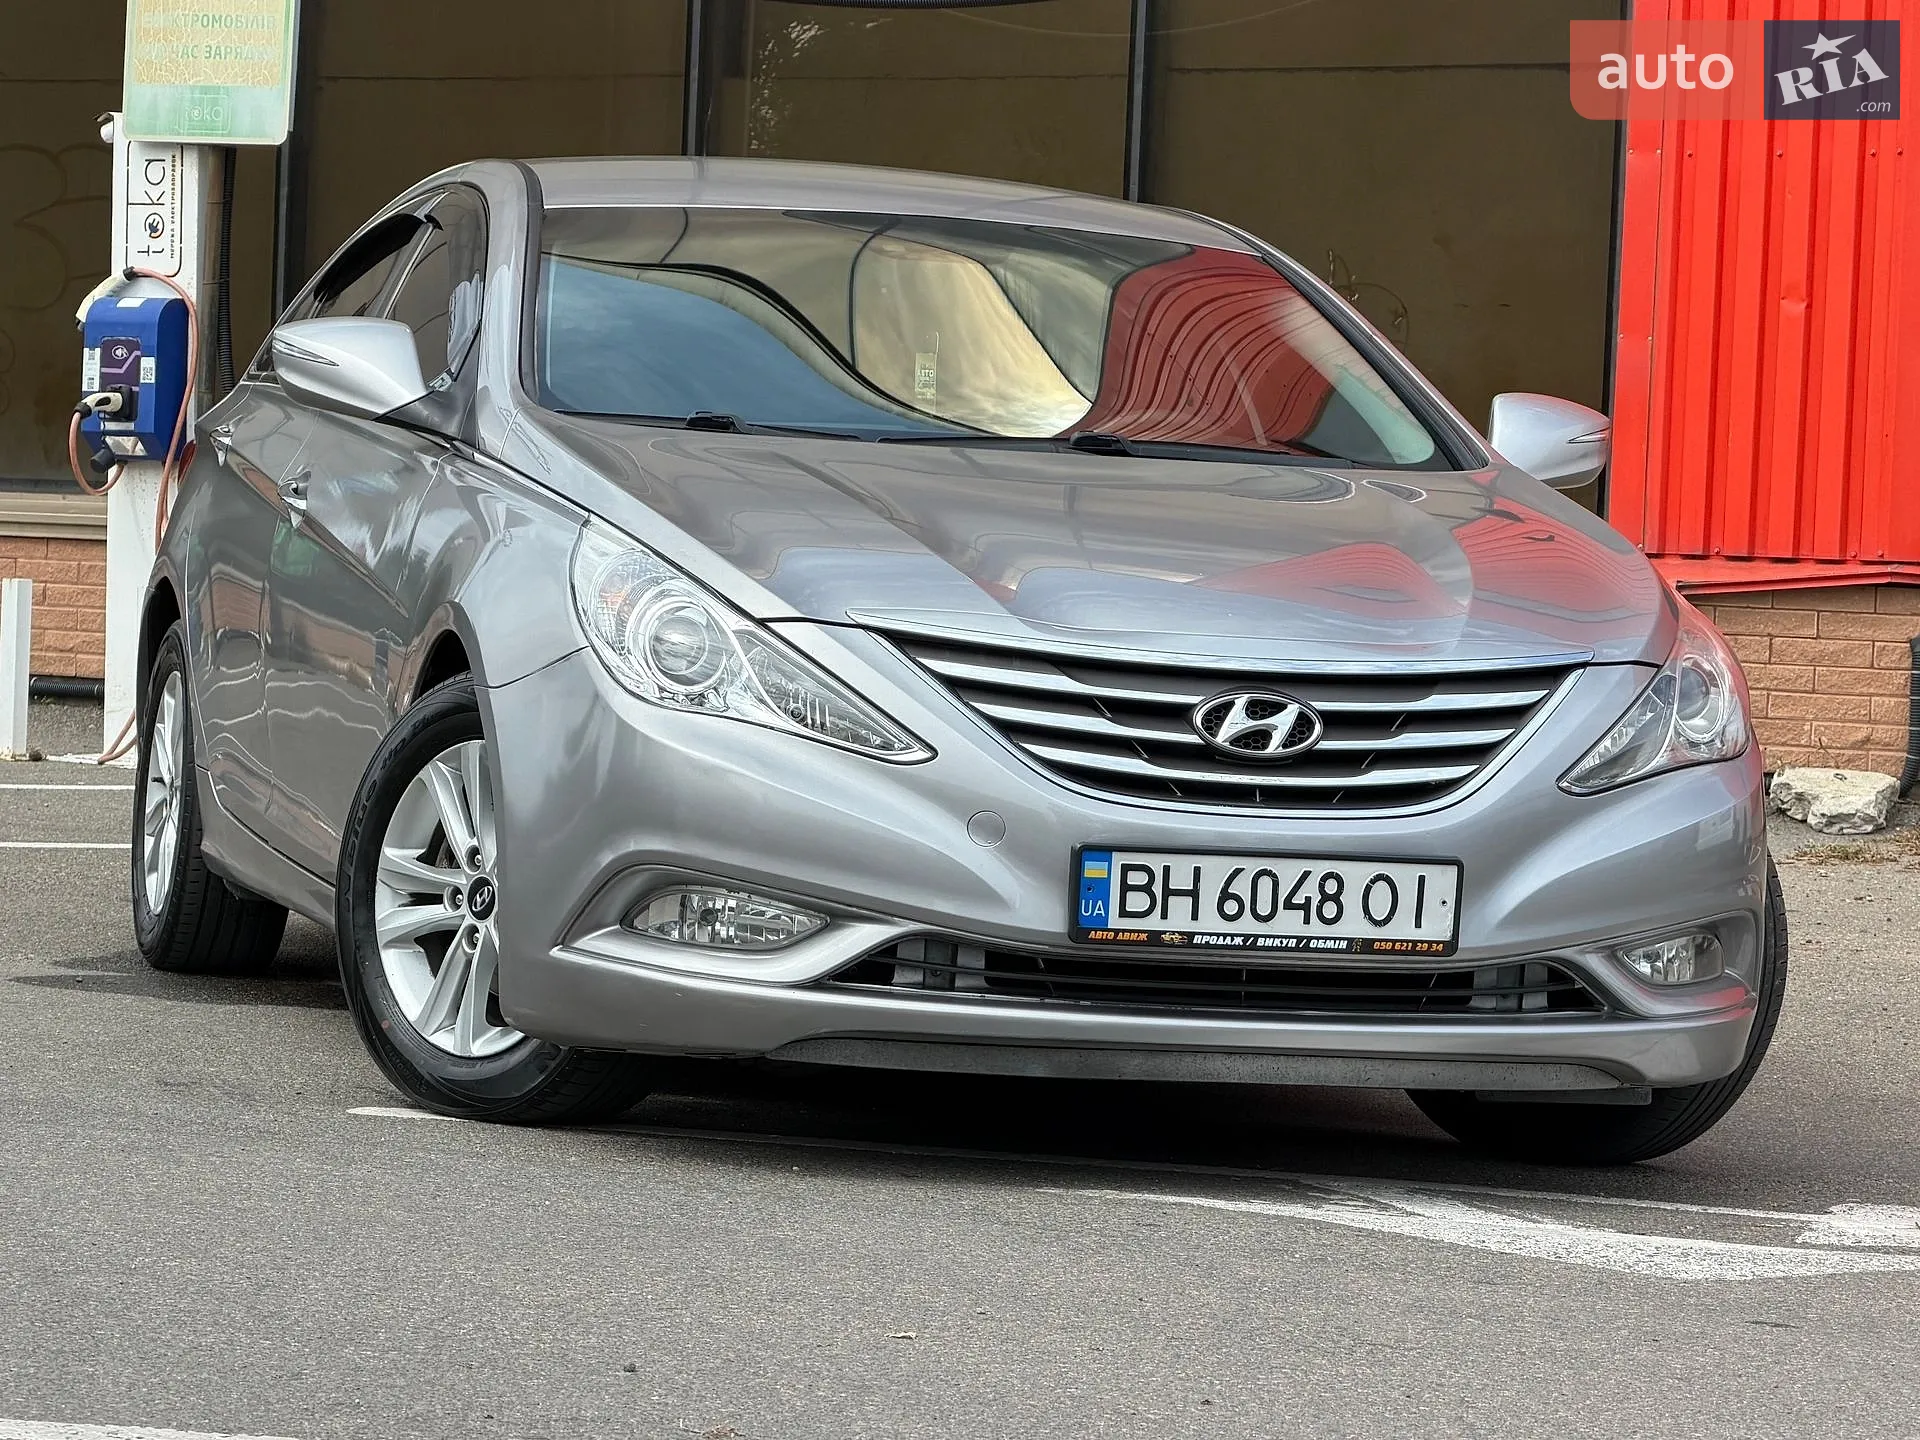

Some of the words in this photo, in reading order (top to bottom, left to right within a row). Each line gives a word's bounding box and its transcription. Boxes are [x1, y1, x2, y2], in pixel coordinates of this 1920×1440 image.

[1117, 862, 1201, 921] BH
[1216, 866, 1345, 927] 6048
[1080, 898, 1105, 917] UA
[1088, 930, 1115, 940] АВТО
[1117, 932, 1149, 942] ДВИЖ
[1193, 934, 1244, 946] ПРОДАЖ
[1257, 938, 1297, 949] ВИКУП
[1309, 939, 1348, 950] ОБМІН
[1373, 941, 1393, 950] 050
[1395, 941, 1413, 951] 621
[1430, 943, 1444, 952] 34
